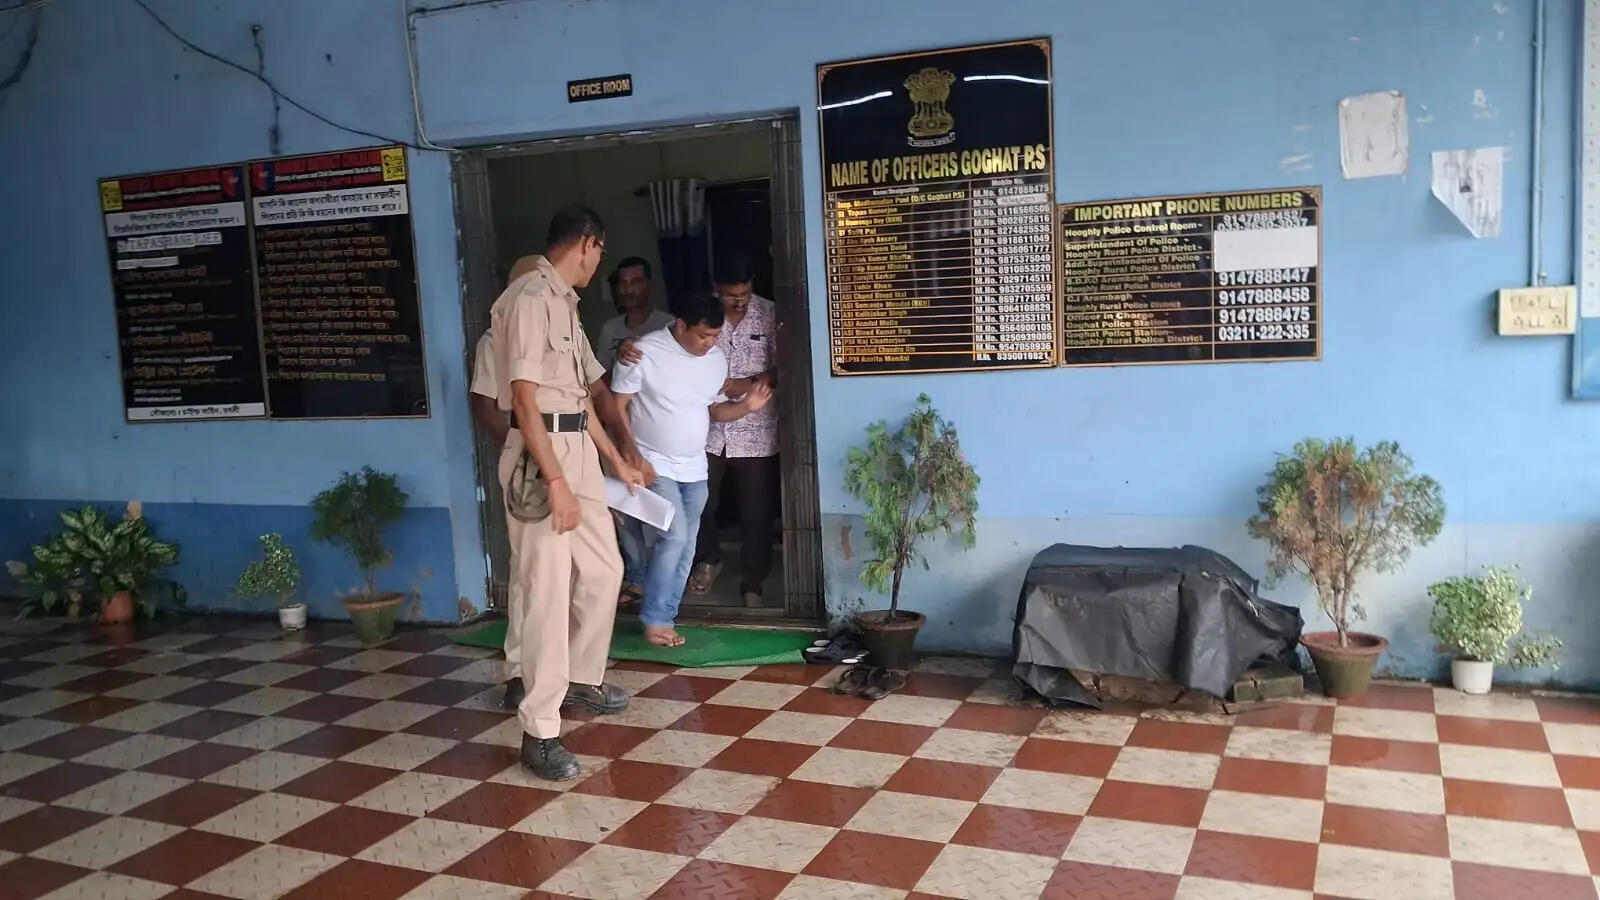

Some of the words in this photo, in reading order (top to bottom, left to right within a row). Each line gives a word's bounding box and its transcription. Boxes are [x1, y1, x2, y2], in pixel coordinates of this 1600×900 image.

[570, 82, 602, 97] OFFICE
[603, 78, 630, 93] ROOM
[831, 161, 869, 187] NAME
[872, 159, 888, 182] OF
[892, 152, 958, 180] OFFICERS
[961, 146, 1020, 176] GOGHAT
[973, 190, 996, 198] M.No.
[1074, 202, 1163, 222] IMPORTANT
[1166, 197, 1221, 216] PHONE
[1224, 191, 1303, 212] NUMBERS
[1065, 227, 1101, 238] Hooghly
[1103, 225, 1132, 235] Police
[1134, 223, 1168, 233] Control
[1065, 238, 1134, 251] Superintendent
[1137, 238, 1147, 246] Of
[1149, 236, 1179, 246] Police
[1066, 248, 1102, 259] Hooghly
[1104, 246, 1129, 256] Rural
[1131, 245, 1160, 255] Police
[1156, 255, 1168, 264] Of
[1170, 254, 1200, 262] Police
[1066, 266, 1102, 277] Hooghly
[1103, 265, 1128, 274] Rural
[1131, 264, 1159, 273] Police
[1161, 262, 1196, 272] District
[1219, 268, 1310, 286] 9147888447
[1100, 275, 1149, 285] Arambagh
[1083, 293, 1132, 302] Arambagh
[1219, 287, 1311, 305] 9147888458
[1115, 312, 1155, 321] Charge
[1219, 306, 1311, 324] 9147888475
[1066, 321, 1099, 330] Goghat
[1219, 324, 1310, 340] 03211-222-335
[1066, 338, 1104, 346] Hooghly
